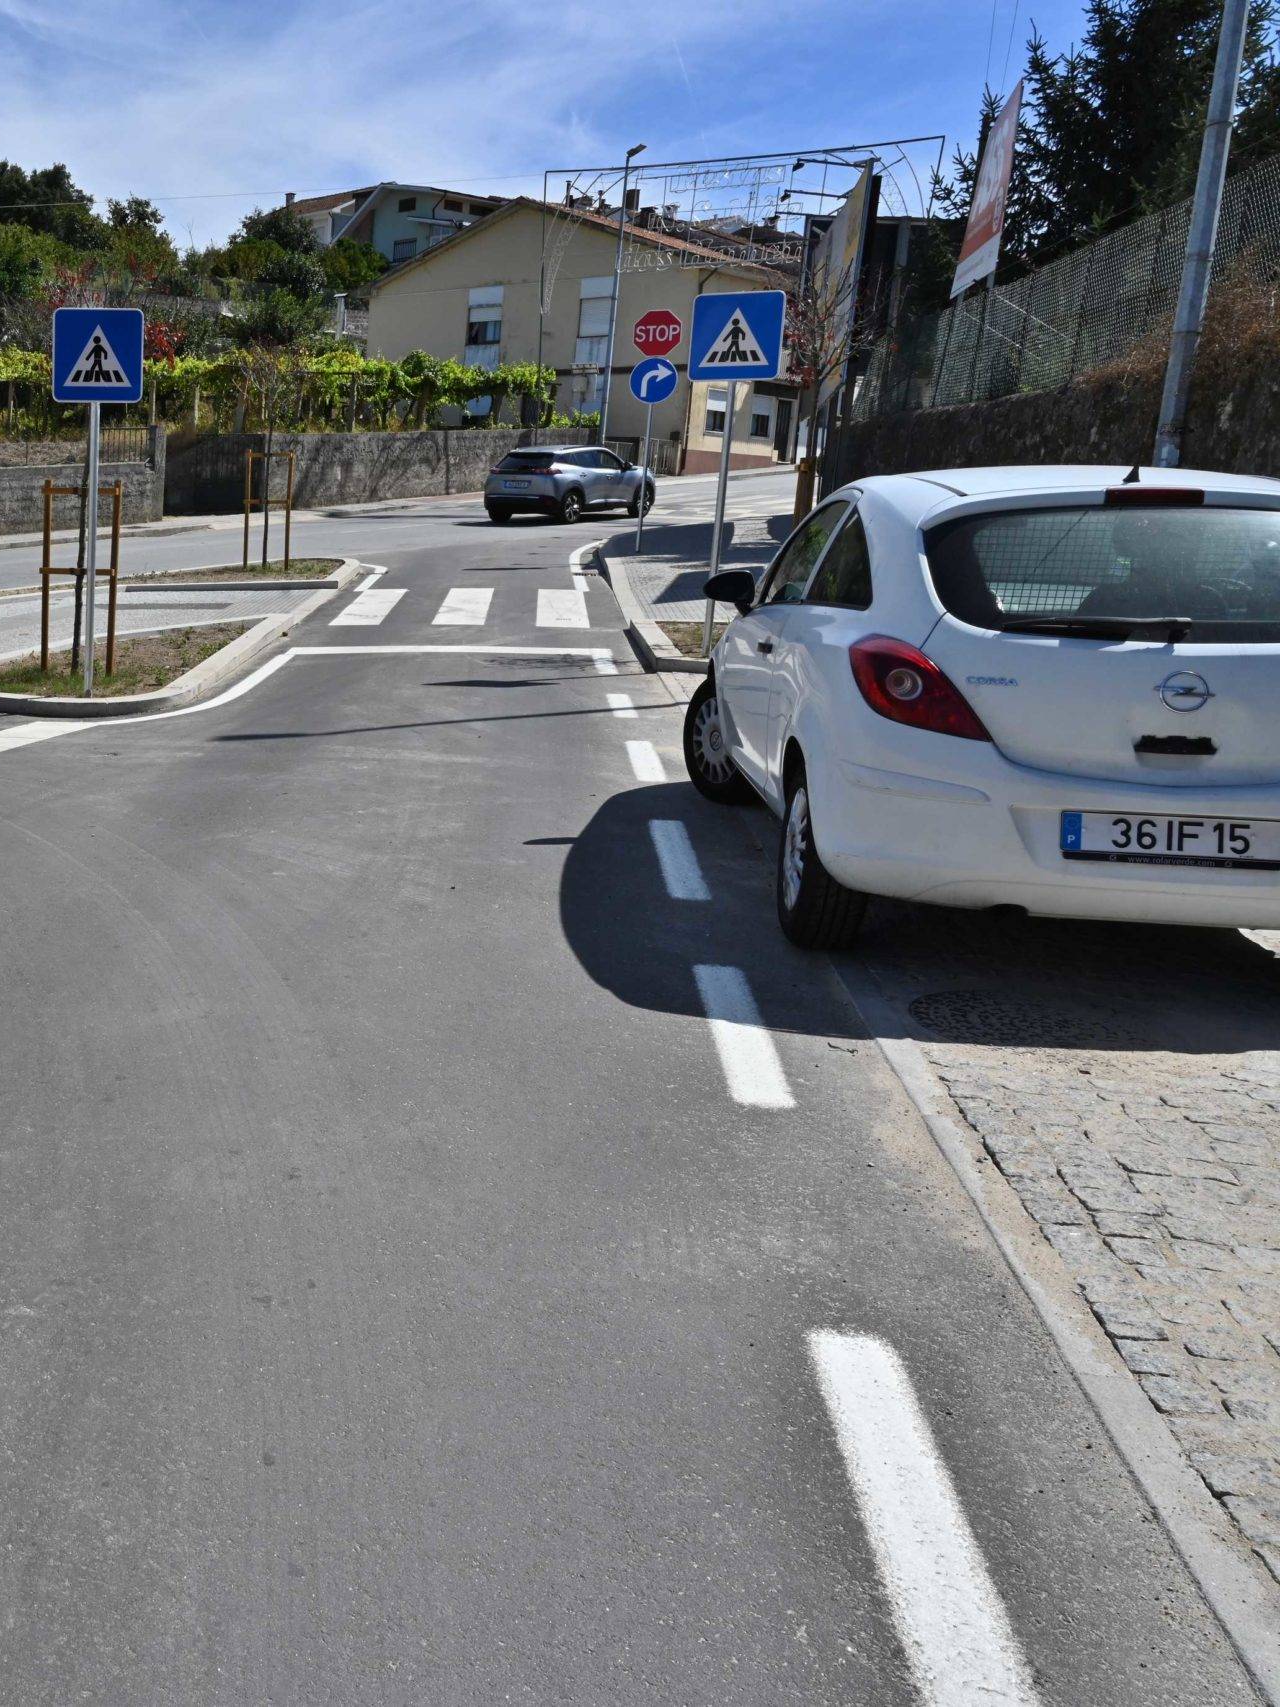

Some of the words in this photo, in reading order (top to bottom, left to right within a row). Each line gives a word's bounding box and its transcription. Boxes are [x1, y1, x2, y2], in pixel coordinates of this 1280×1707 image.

[635, 324, 680, 342] STOP
[965, 675, 1019, 687] CORSA
[1067, 834, 1076, 844] P
[1111, 818, 1158, 850] 36
[1166, 820, 1205, 851] IF
[1212, 823, 1251, 855] 15
